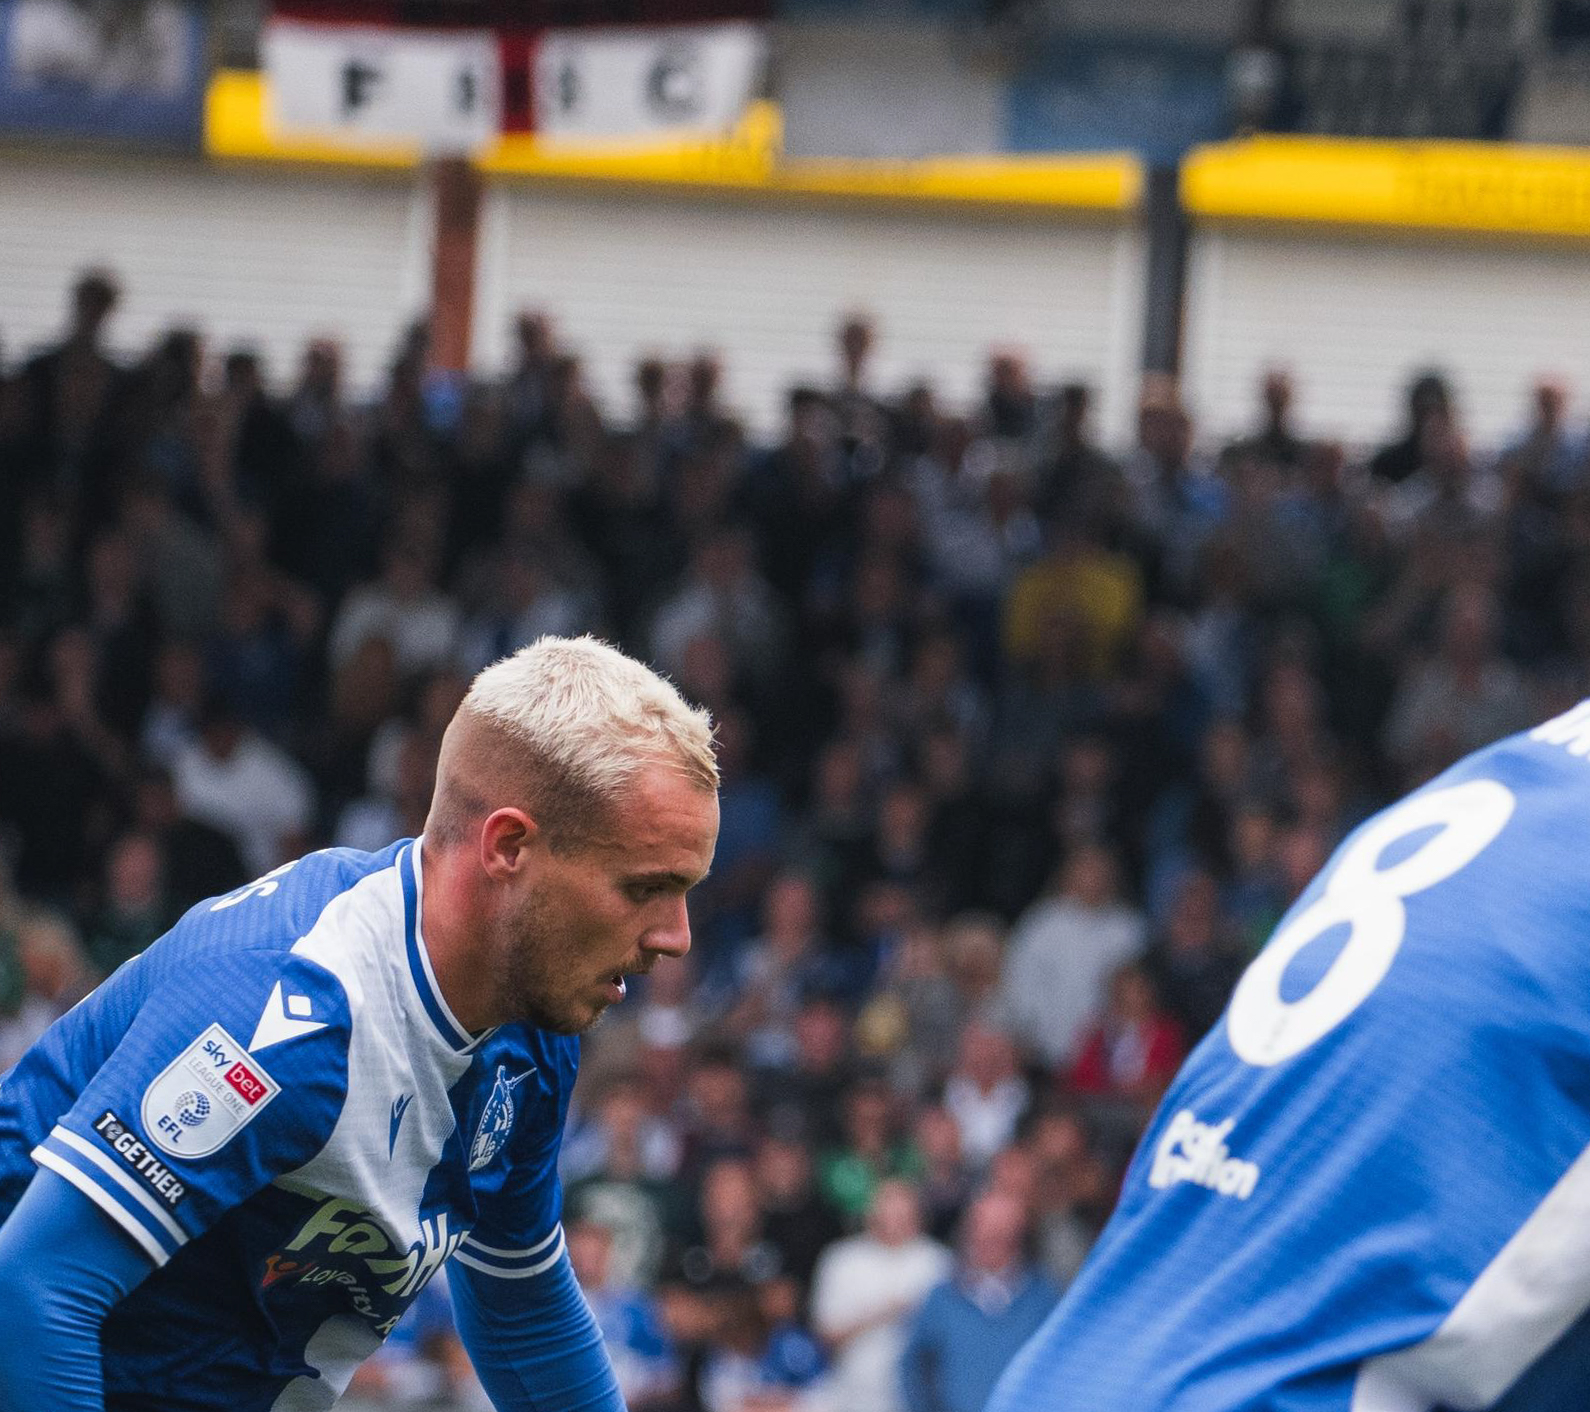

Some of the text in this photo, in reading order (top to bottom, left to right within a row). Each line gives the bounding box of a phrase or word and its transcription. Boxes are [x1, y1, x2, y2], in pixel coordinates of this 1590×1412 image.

[1227, 778, 1517, 1067] 8
[188, 1056, 247, 1117] LEAGUE ONE
[202, 1039, 262, 1099] sky bet
[157, 1114, 185, 1144] EFL
